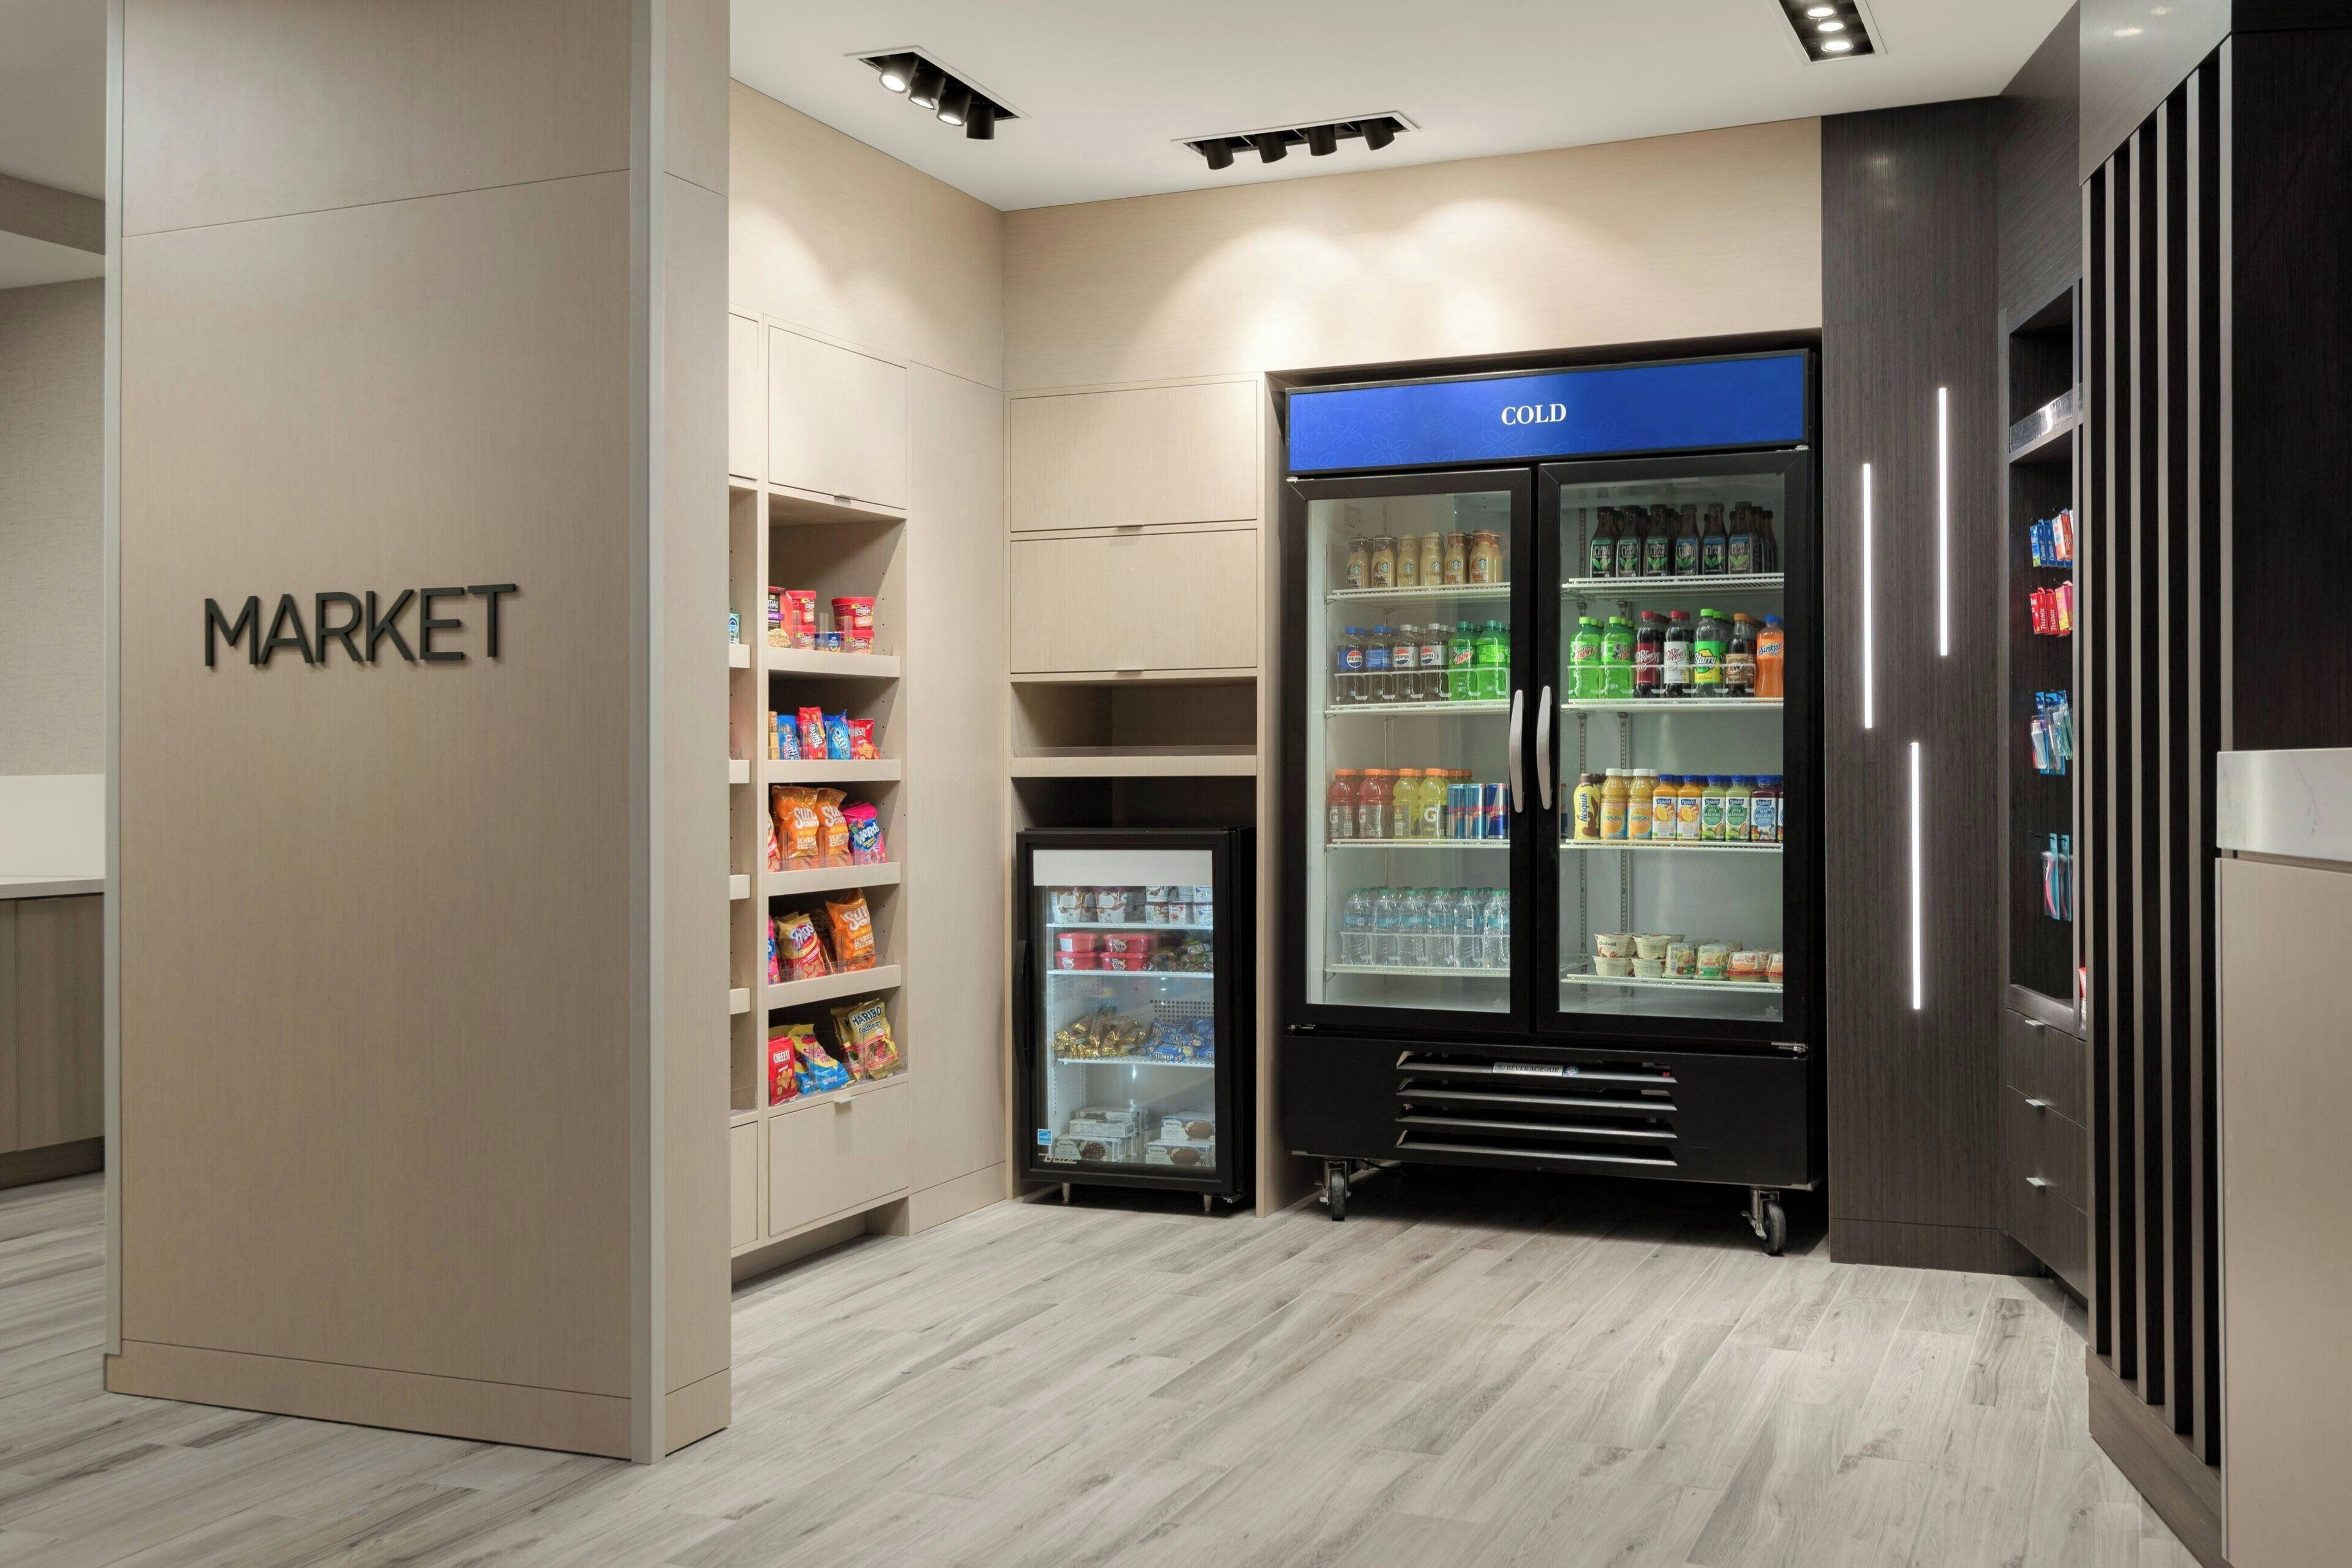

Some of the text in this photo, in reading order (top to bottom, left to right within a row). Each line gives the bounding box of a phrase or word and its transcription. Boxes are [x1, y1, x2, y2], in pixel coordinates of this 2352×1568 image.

[1501, 403, 1567, 426] COLD
[205, 584, 516, 666] MARKET
[1665, 650, 1686, 662] Pepper
[1759, 643, 1782, 655] Sunkist
[1635, 652, 1655, 664] Pepper
[1695, 653, 1717, 669] Starry
[1579, 793, 1590, 822] Nesquik
[852, 1006, 883, 1027] HARIBO
[859, 1019, 883, 1034] Goldbears
[1506, 1064, 1560, 1073] BEVERAGE-AIR
